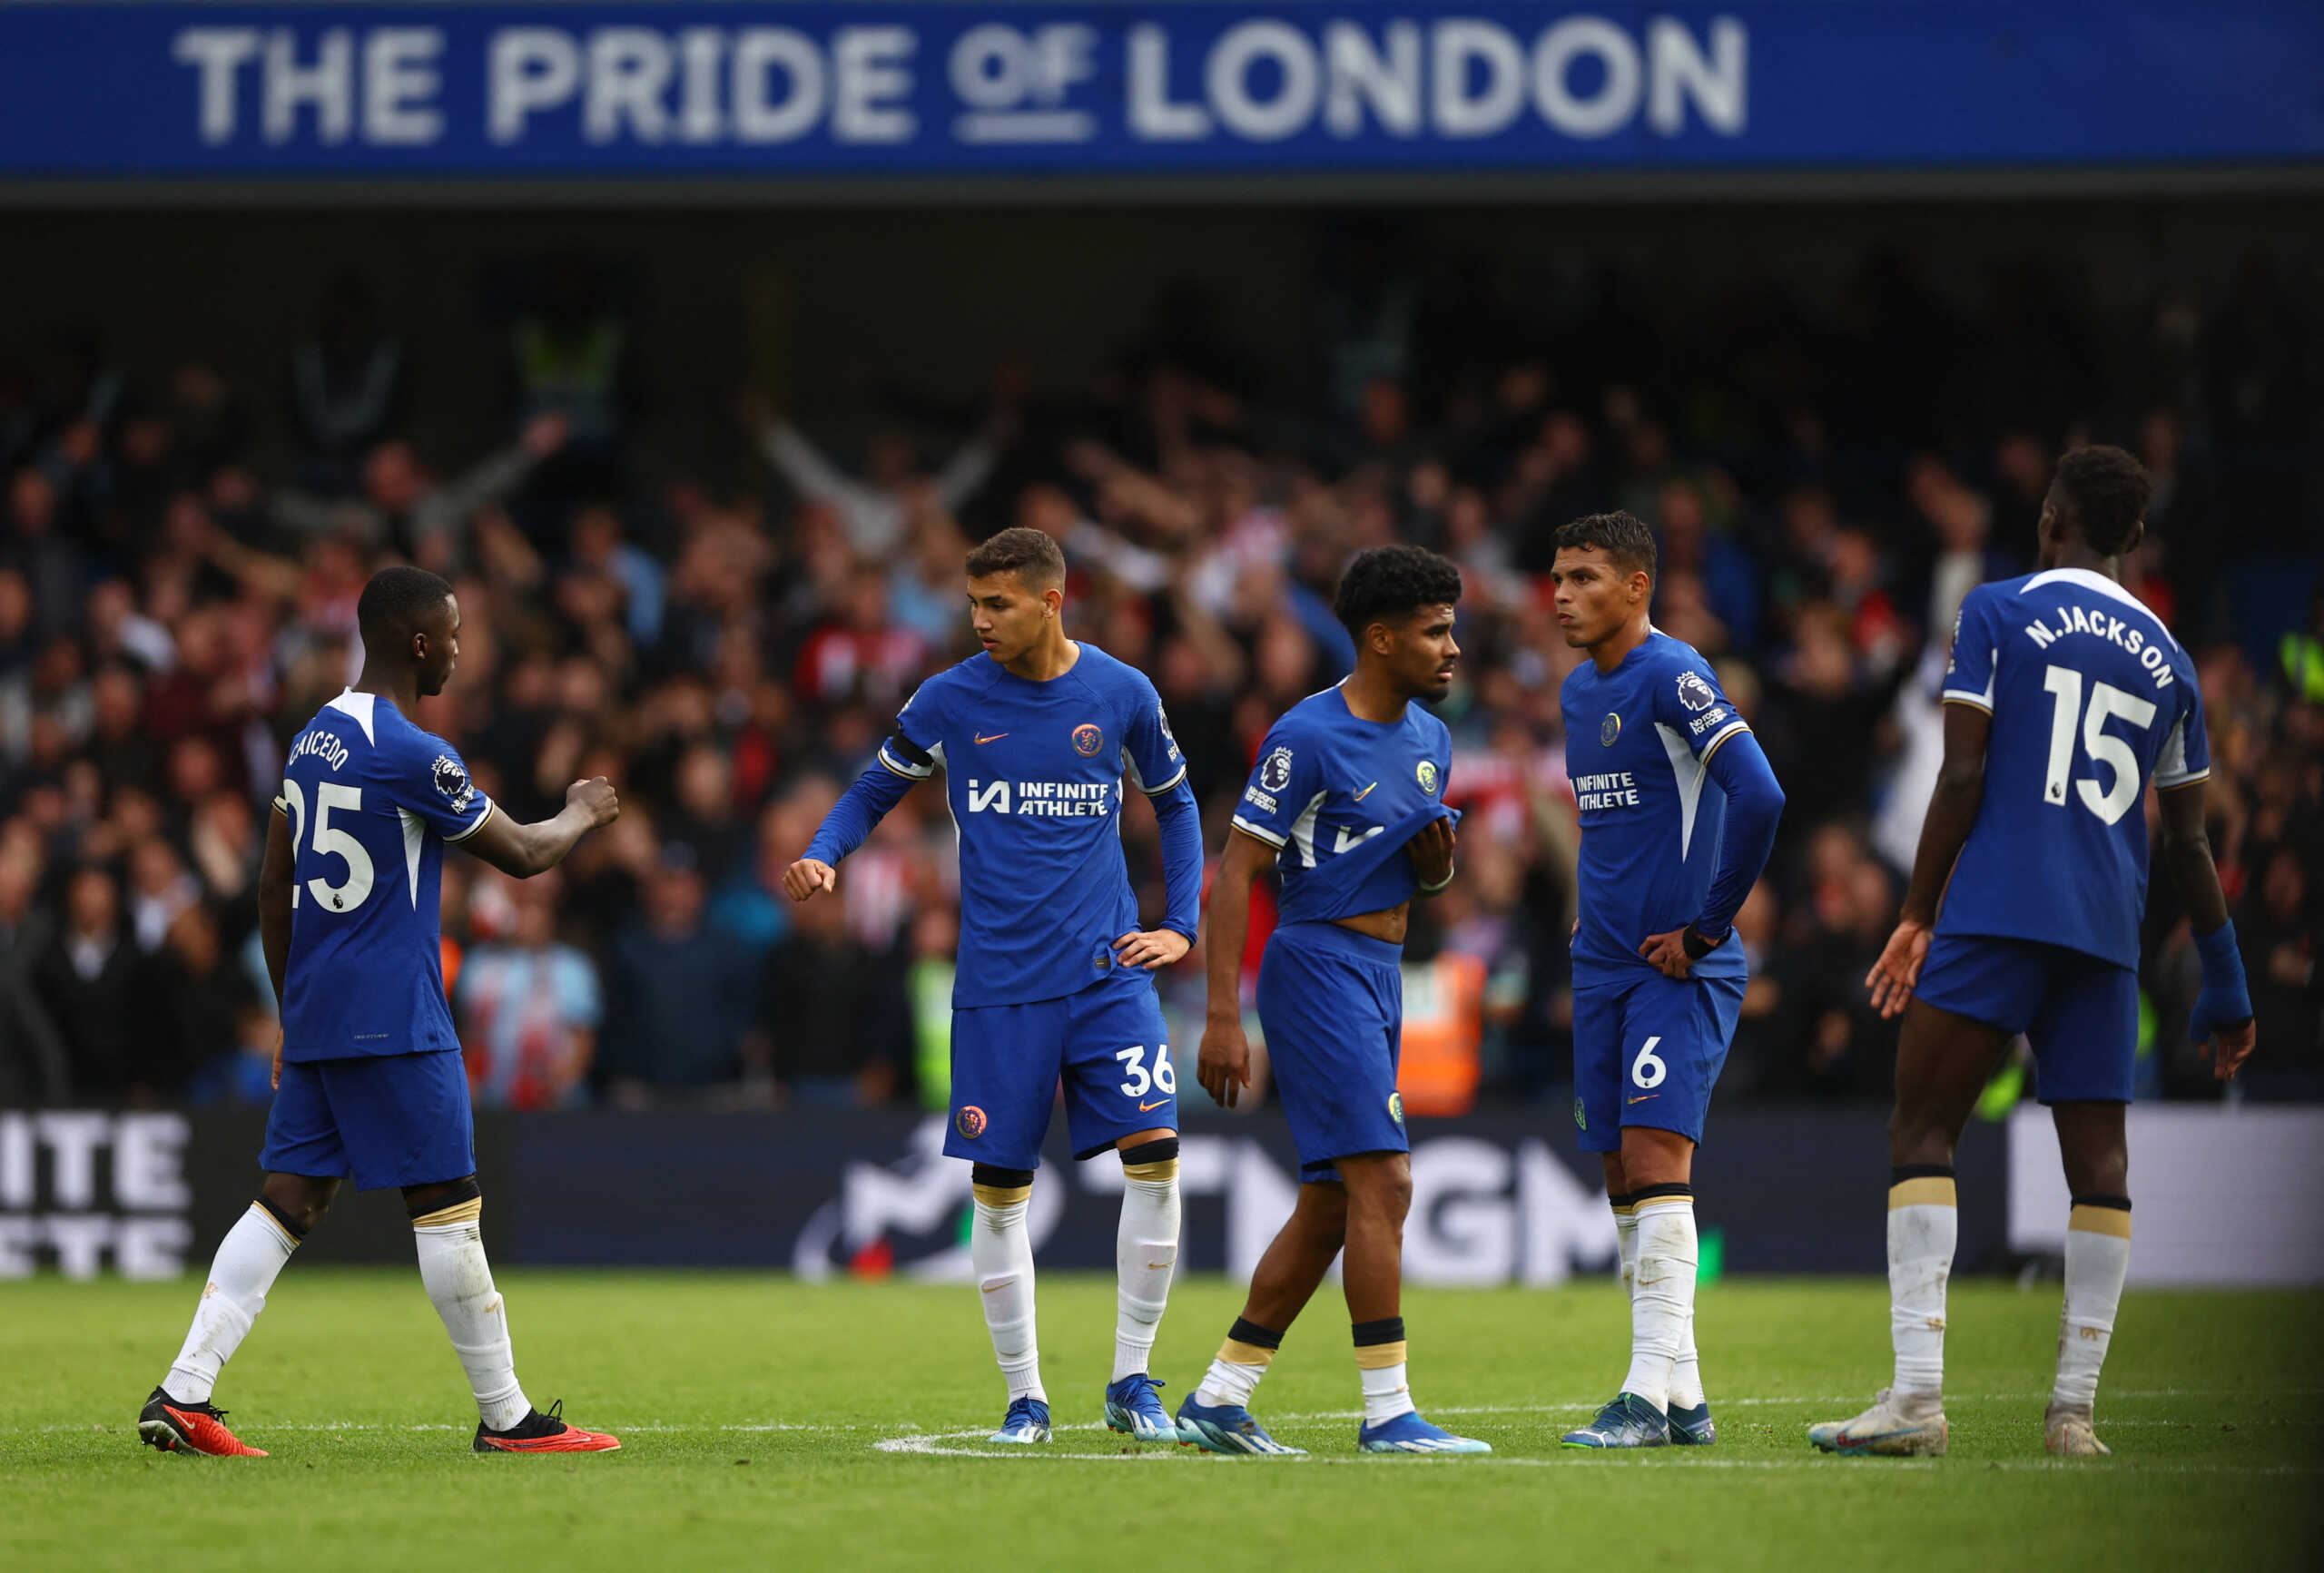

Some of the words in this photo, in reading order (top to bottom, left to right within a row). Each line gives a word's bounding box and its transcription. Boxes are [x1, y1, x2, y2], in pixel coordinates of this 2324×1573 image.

[178, 29, 439, 143] THE
[489, 27, 913, 143] PRIDE
[952, 24, 1089, 105] OF
[1129, 17, 1747, 139] LONDON
[2025, 605, 2173, 689] N.JACKSON
[289, 731, 349, 772] CAICEDO
[2044, 664, 2157, 825] 15
[1017, 799, 1108, 817] ATHLETE
[1019, 782, 1109, 800] INFINITE
[1576, 772, 1636, 792] INFINITE
[1116, 1044, 1177, 1097] 36
[1631, 1036, 1667, 1089] 6
